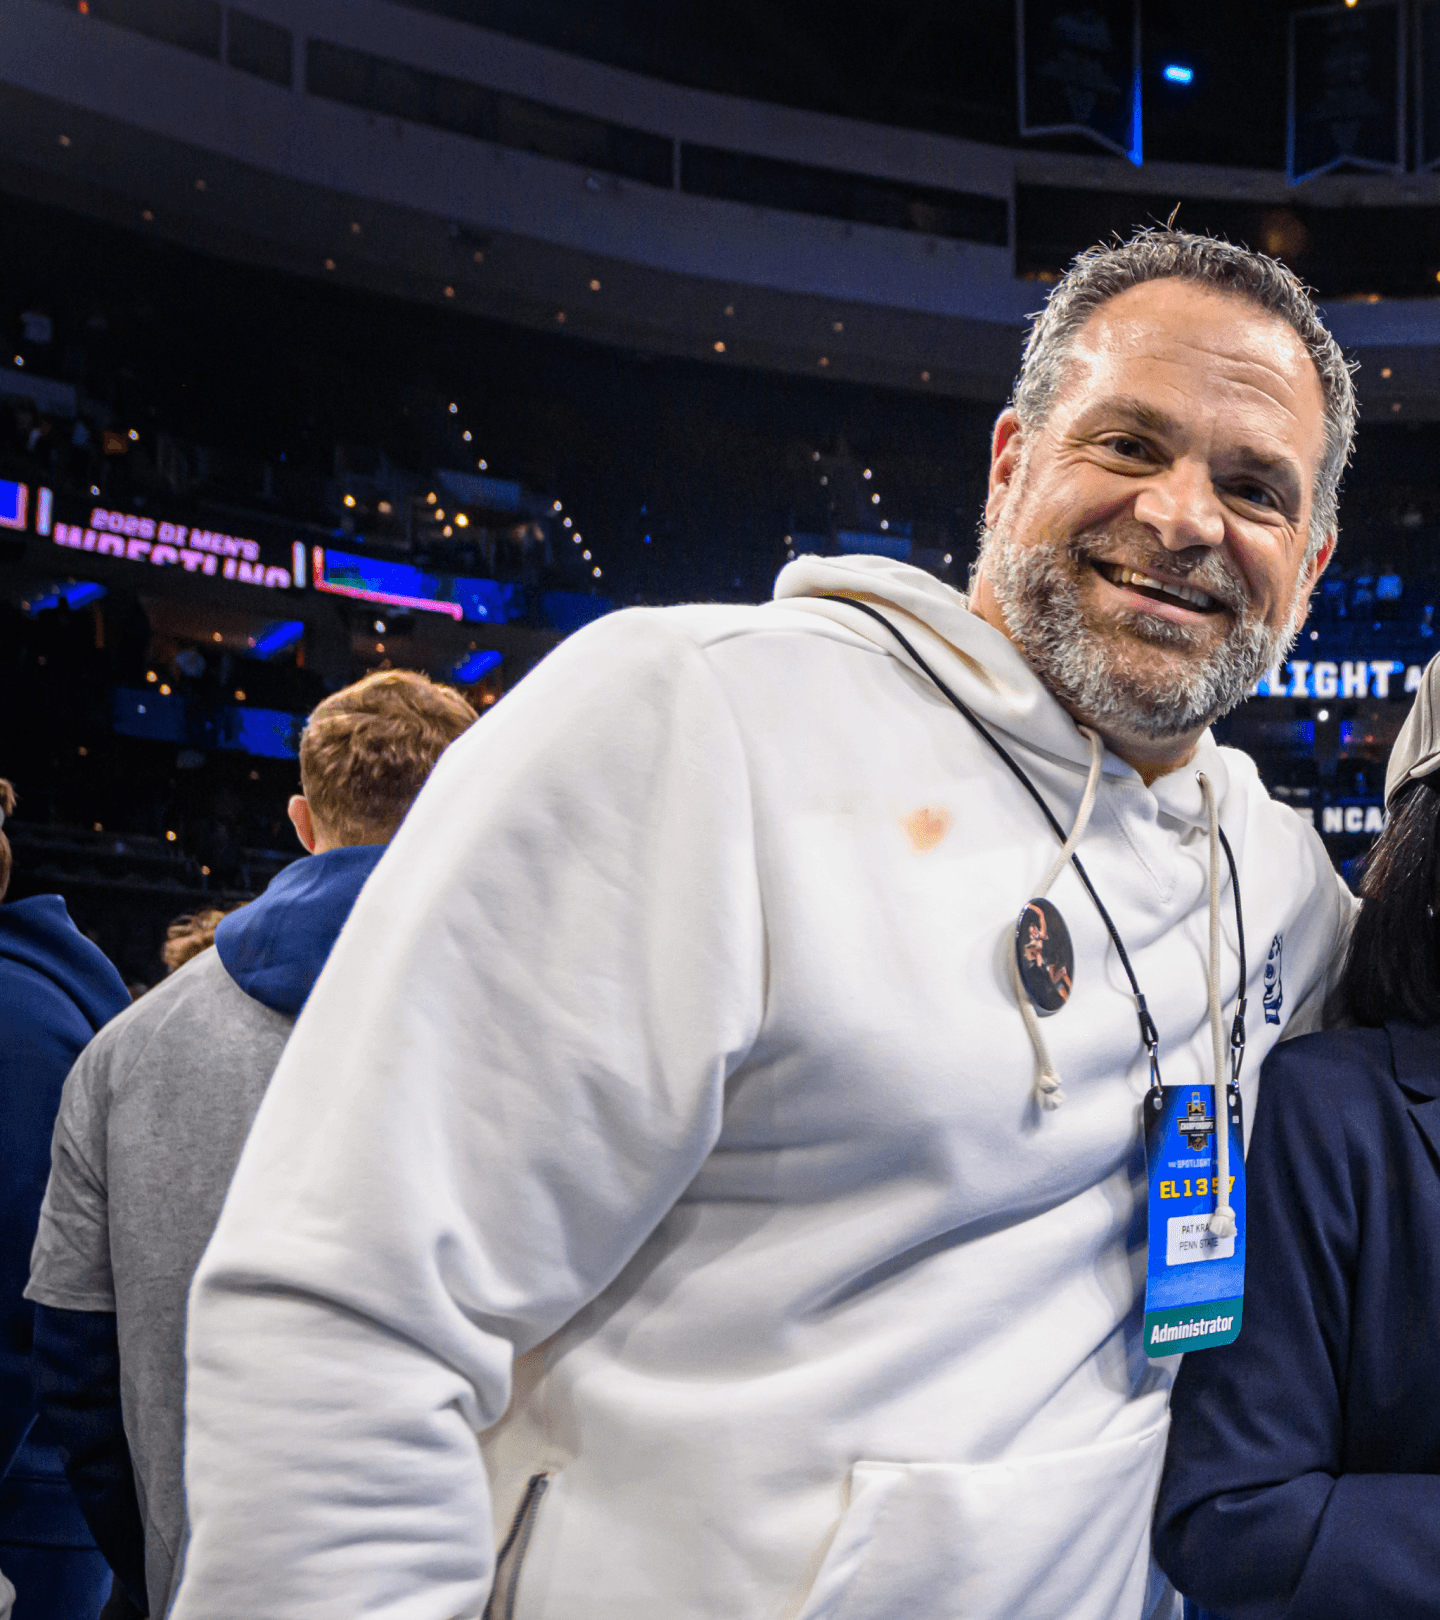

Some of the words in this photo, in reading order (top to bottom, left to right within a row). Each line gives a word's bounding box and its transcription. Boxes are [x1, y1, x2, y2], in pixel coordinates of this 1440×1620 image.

[1251, 660, 1398, 699] LIGHT
[1322, 806, 1387, 834] NCA
[1181, 1224, 1195, 1235] PAT
[1196, 1222, 1211, 1234] KRA
[1179, 1241, 1198, 1251] PENN
[1199, 1237, 1219, 1249] STATE
[1150, 1315, 1234, 1345] Administrator
